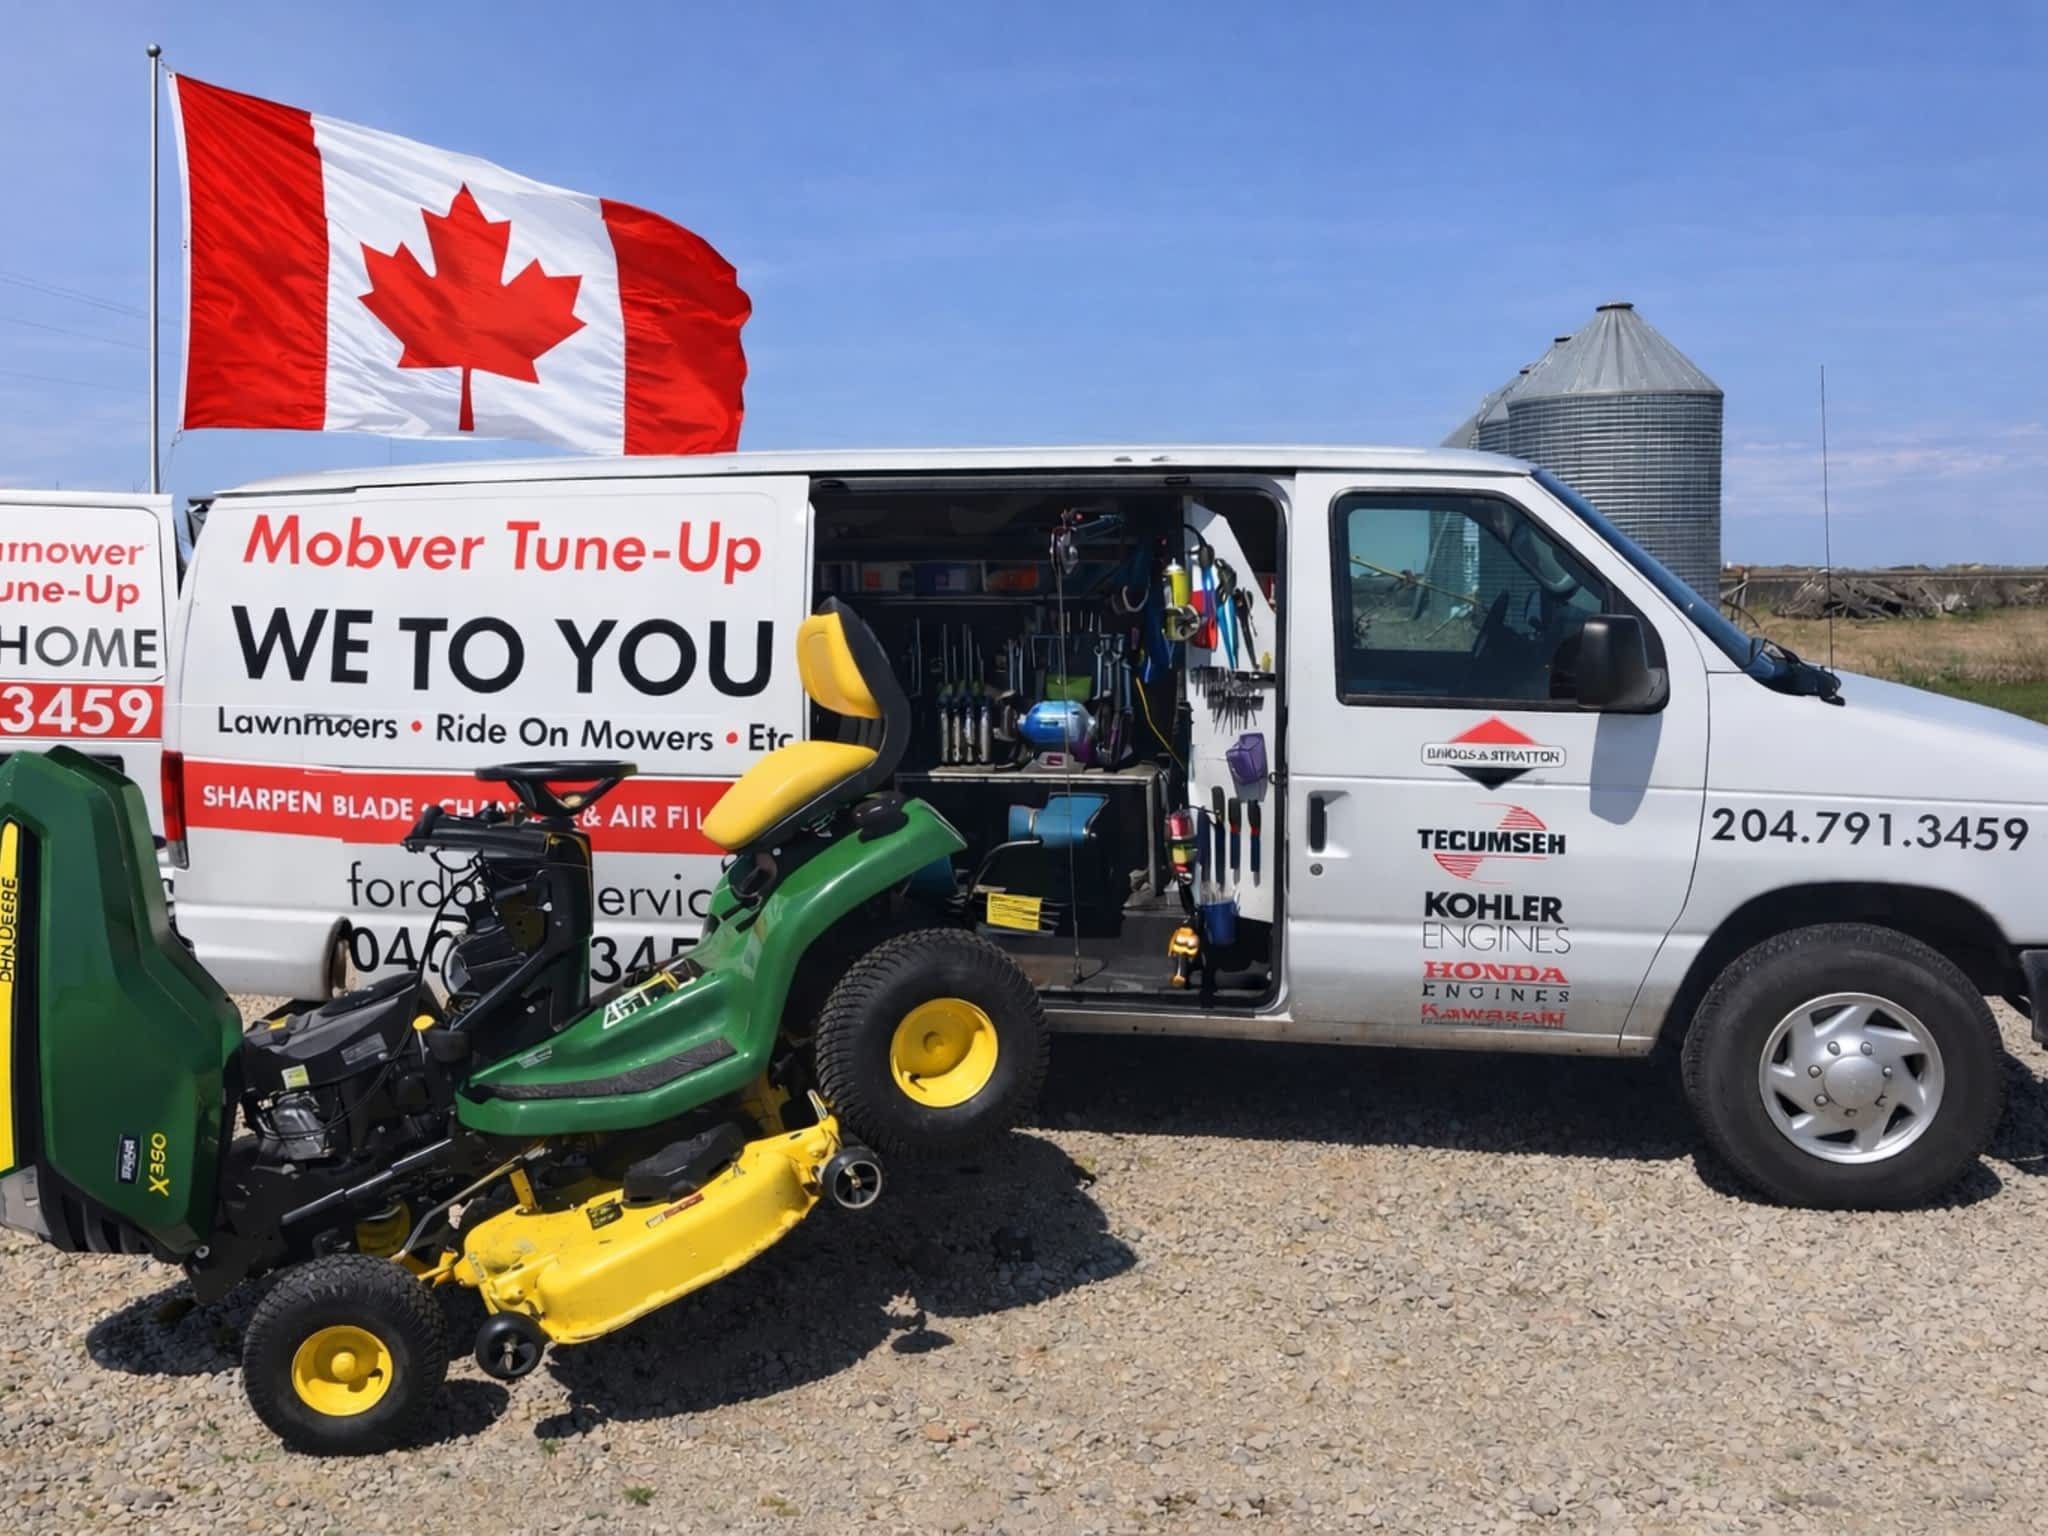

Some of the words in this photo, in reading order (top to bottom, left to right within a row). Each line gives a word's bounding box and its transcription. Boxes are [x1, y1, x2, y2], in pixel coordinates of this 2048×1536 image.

[243, 514, 486, 571] Mobver
[506, 520, 762, 584] Tune-Up
[0, 574, 140, 613] une-Up
[0, 625, 157, 668] HOME
[231, 605, 374, 684] WE
[399, 616, 525, 694] TO
[555, 617, 774, 697] YOU
[0, 686, 153, 735] 3459
[436, 713, 507, 744] Ride
[519, 717, 568, 747] On
[581, 719, 713, 751] Mowers
[203, 785, 322, 815] SHARPEN
[333, 795, 413, 822] BLADE
[609, 804, 656, 828] AIR
[667, 805, 704, 831] FIL
[1711, 807, 2029, 851] 204.791.3459
[1417, 829, 1566, 854] TECUMSEH
[597, 873, 713, 918] ervic
[1425, 891, 1564, 924] KOHLER
[1423, 921, 1571, 954] ENGINES
[1424, 961, 1568, 984] HONDA
[149, 1132, 170, 1197] X350
